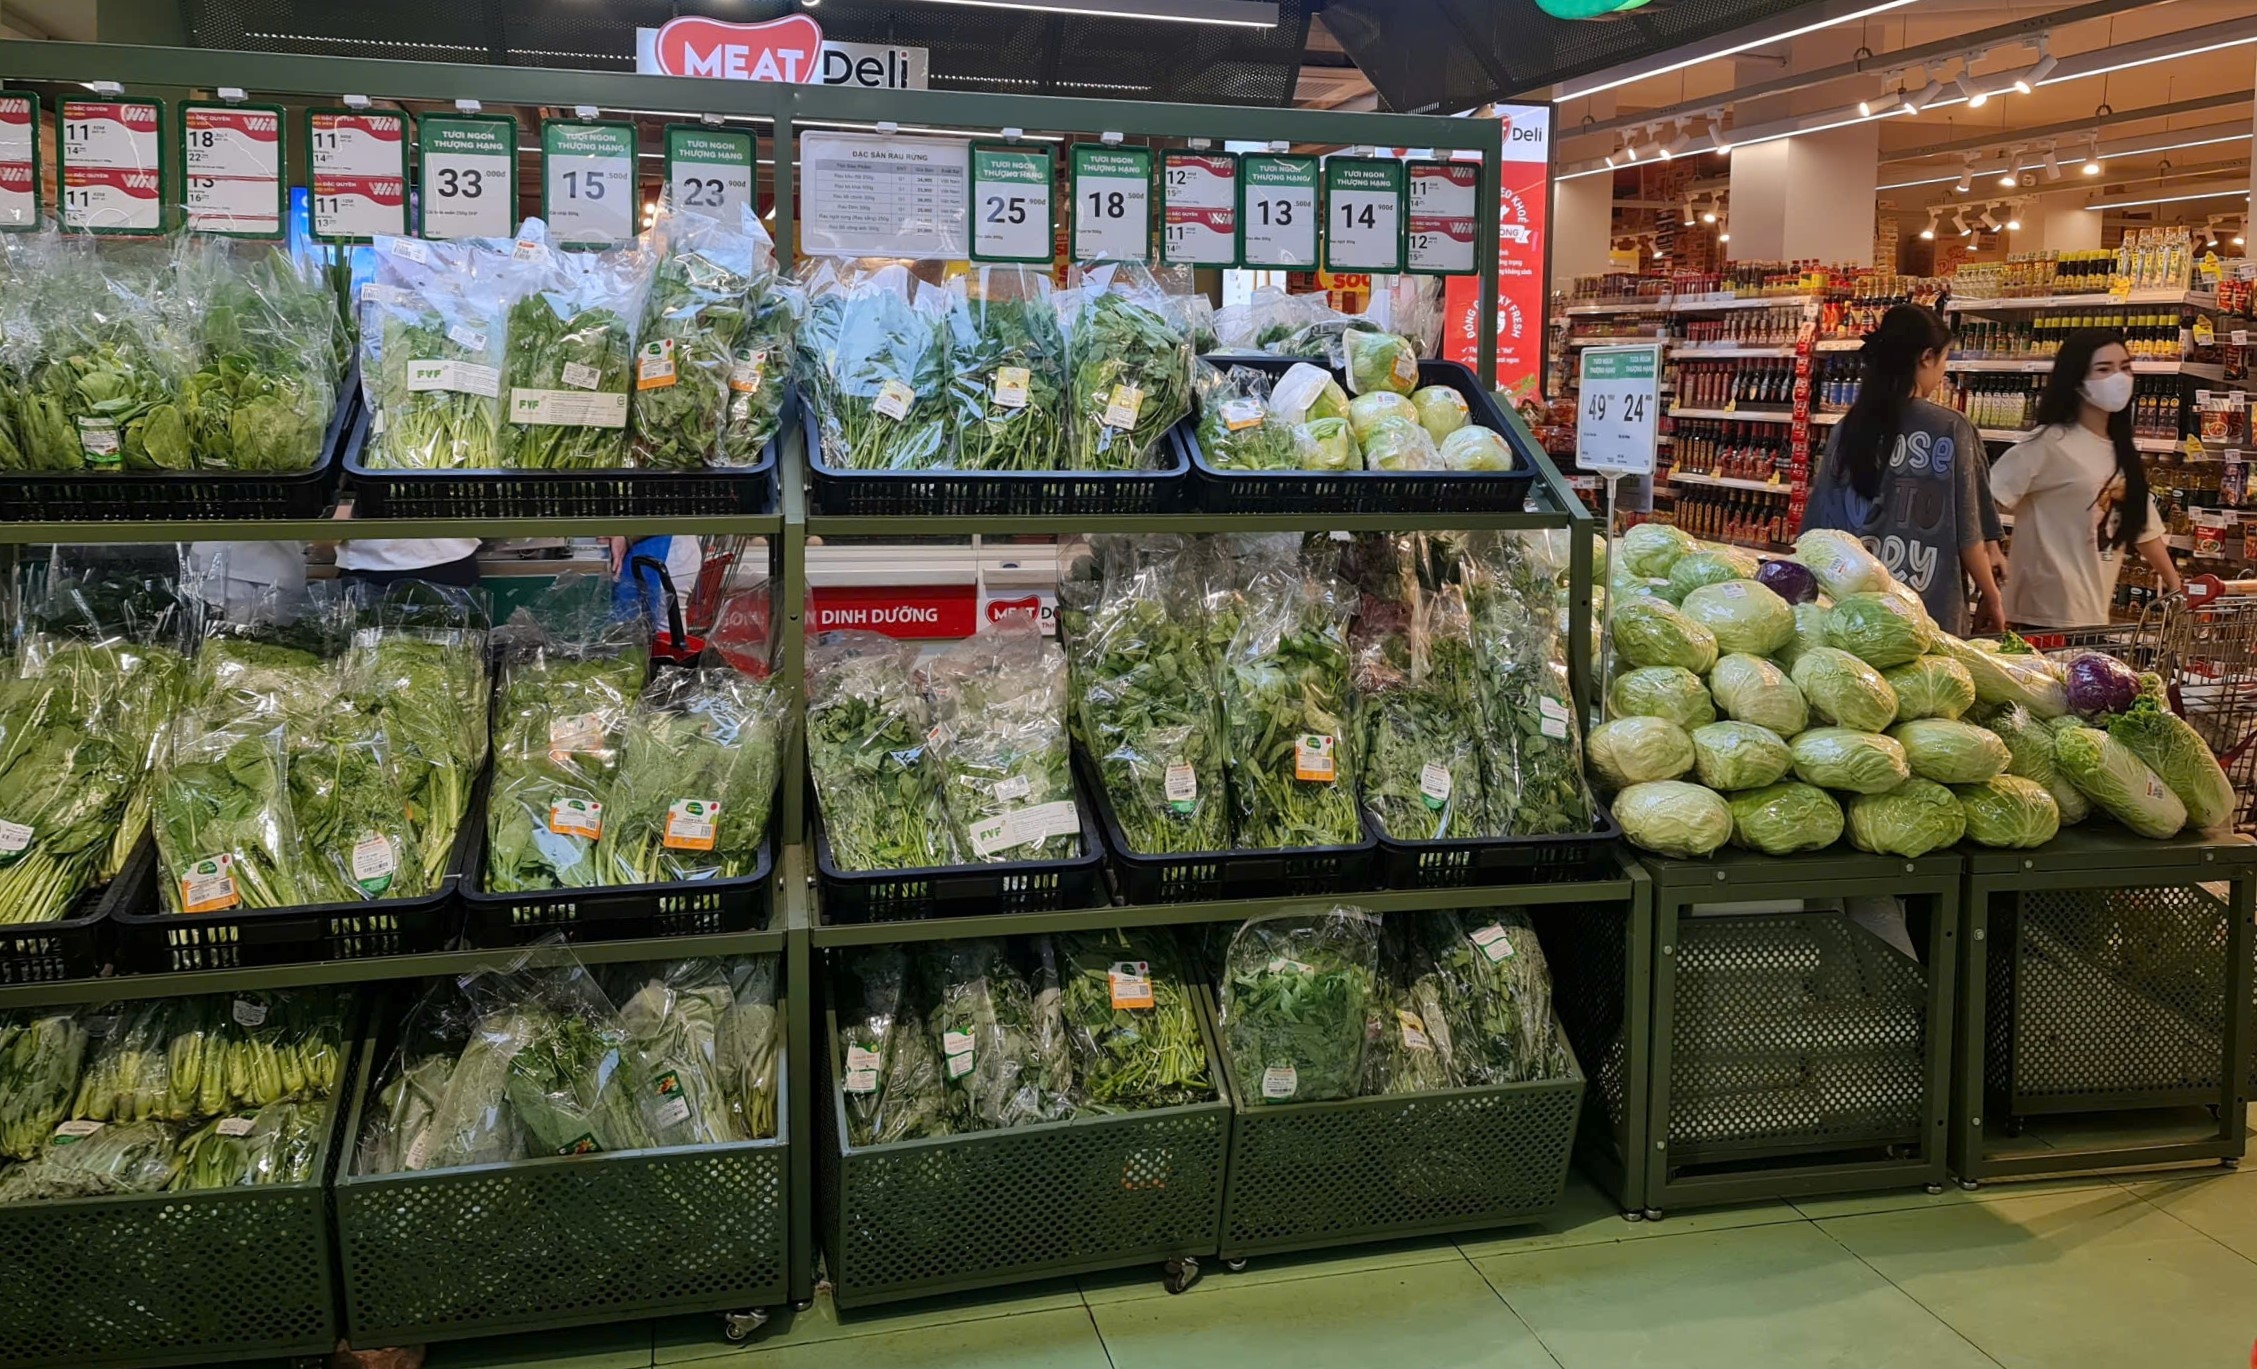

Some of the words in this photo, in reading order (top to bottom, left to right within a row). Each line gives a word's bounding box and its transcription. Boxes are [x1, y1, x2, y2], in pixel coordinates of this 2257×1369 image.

[684, 41, 804, 81] MEAT
[823, 50, 907, 88] Deli
[66, 124, 88, 140] 11
[189, 131, 214, 147] 18
[442, 130, 465, 139] TƯƠI
[467, 132, 495, 140] NGON
[1512, 127, 1542, 142] Deli
[314, 133, 335, 148] 11
[434, 140, 474, 150] THƯỢNG
[476, 142, 503, 151] HẠNG
[687, 139, 708, 149] TƯƠI
[709, 141, 735, 150] NGON
[189, 153, 201, 161] 22
[315, 154, 326, 162] 14
[679, 148, 717, 158] THƯỢNG
[717, 151, 743, 161] HẠNG
[1090, 155, 1110, 164] TƯƠI
[1111, 156, 1134, 165] NGON
[1083, 163, 1118, 174] THƯỢNG
[1118, 164, 1140, 175] HẠNG
[1343, 169, 1363, 178] TƯƠI
[1363, 170, 1385, 179] NGON
[438, 168, 482, 198] 33
[1167, 170, 1186, 184] 12
[1336, 178, 1369, 188] THƯỢNG
[1369, 179, 1391, 189] HẠNG
[562, 170, 606, 200] 15
[683, 178, 725, 207] 23
[1411, 181, 1426, 195] 11
[316, 198, 338, 213] 11
[986, 196, 1026, 224] 25
[1088, 191, 1125, 219] 18
[1257, 200, 1292, 226] 13
[1341, 203, 1376, 229] 14
[1167, 226, 1183, 240] 11
[1410, 235, 1428, 249] 12
[1509, 304, 1523, 338] FRESH
[417, 369, 442, 378] FVF
[519, 400, 540, 410] FVF
[1588, 394, 1606, 420] 49
[1623, 394, 1644, 422] 24
[821, 608, 867, 625] DINH
[871, 605, 938, 623] DƯỠNG
[980, 826, 1001, 841] FVF
